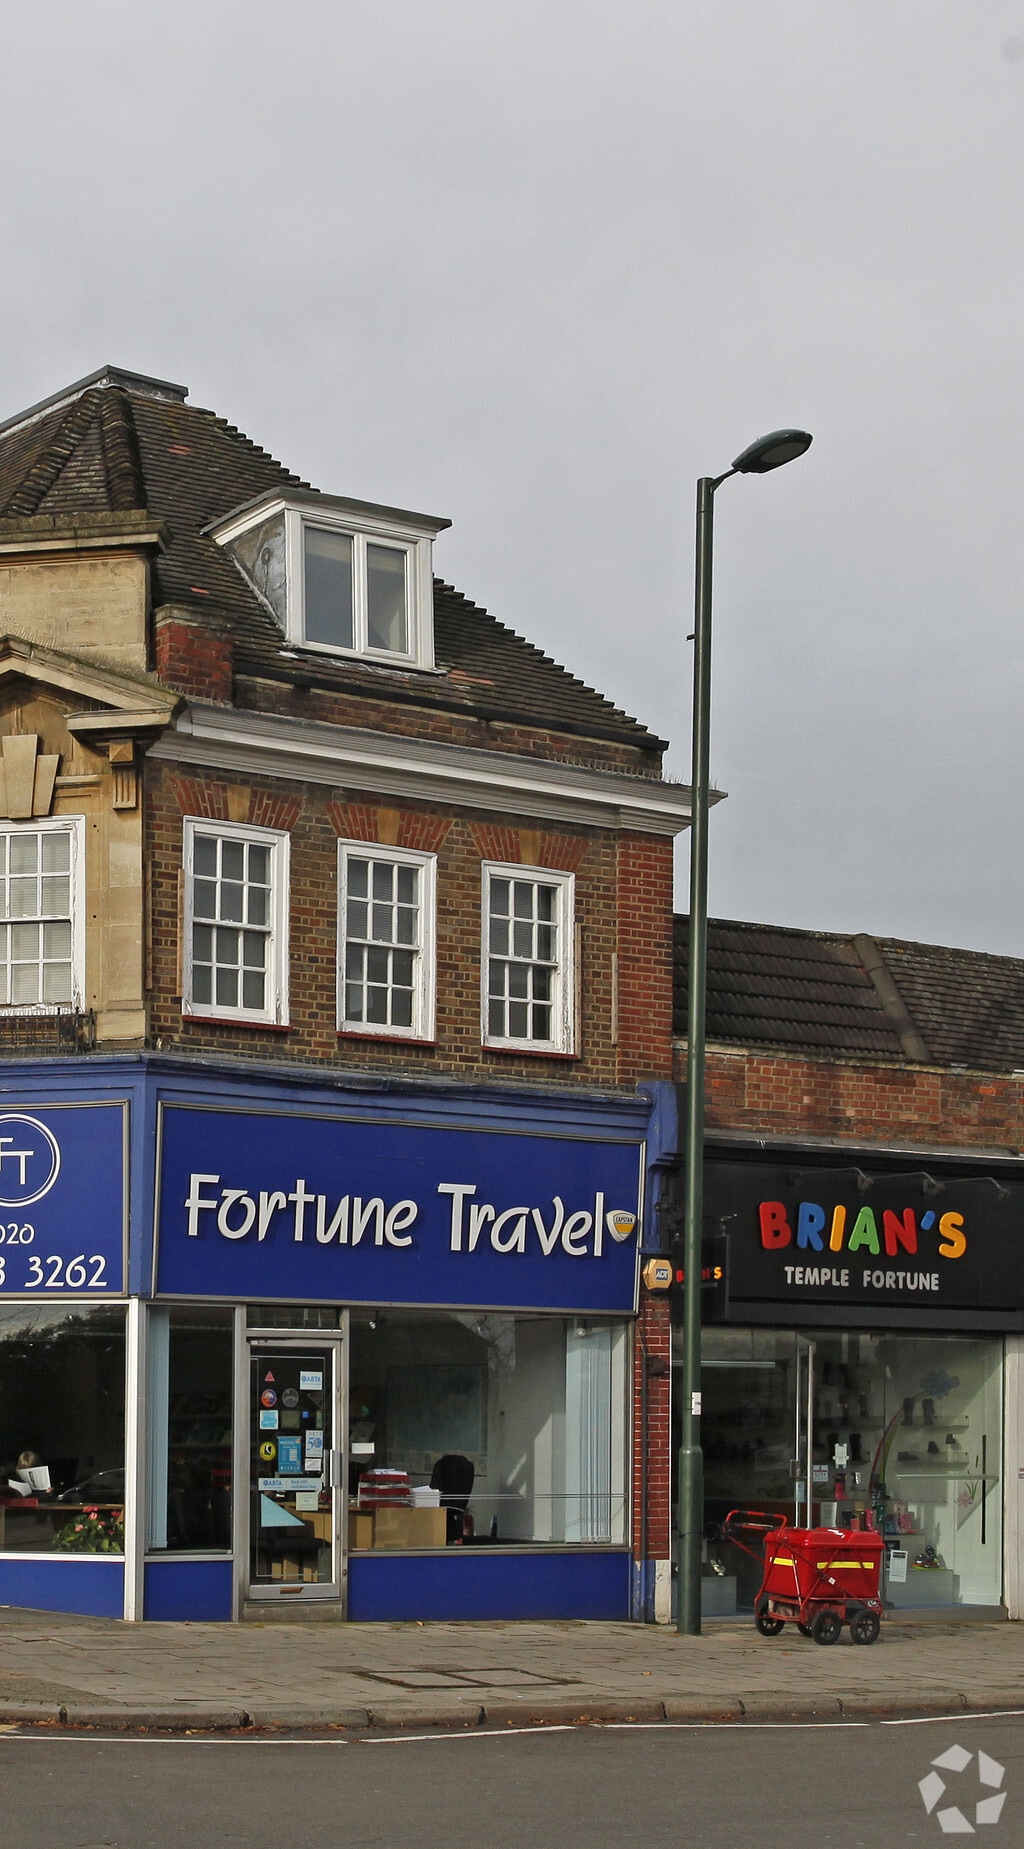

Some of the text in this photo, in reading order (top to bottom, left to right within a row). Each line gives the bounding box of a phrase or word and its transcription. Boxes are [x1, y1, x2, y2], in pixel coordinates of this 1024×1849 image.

[184, 1173, 605, 1257] Fortune Travel
[758, 1200, 967, 1259] BRIAN'S
[24, 1254, 108, 1288] 3262
[656, 1270, 668, 1278] ADT
[784, 1266, 940, 1291] TEMPLE FORTUNE
